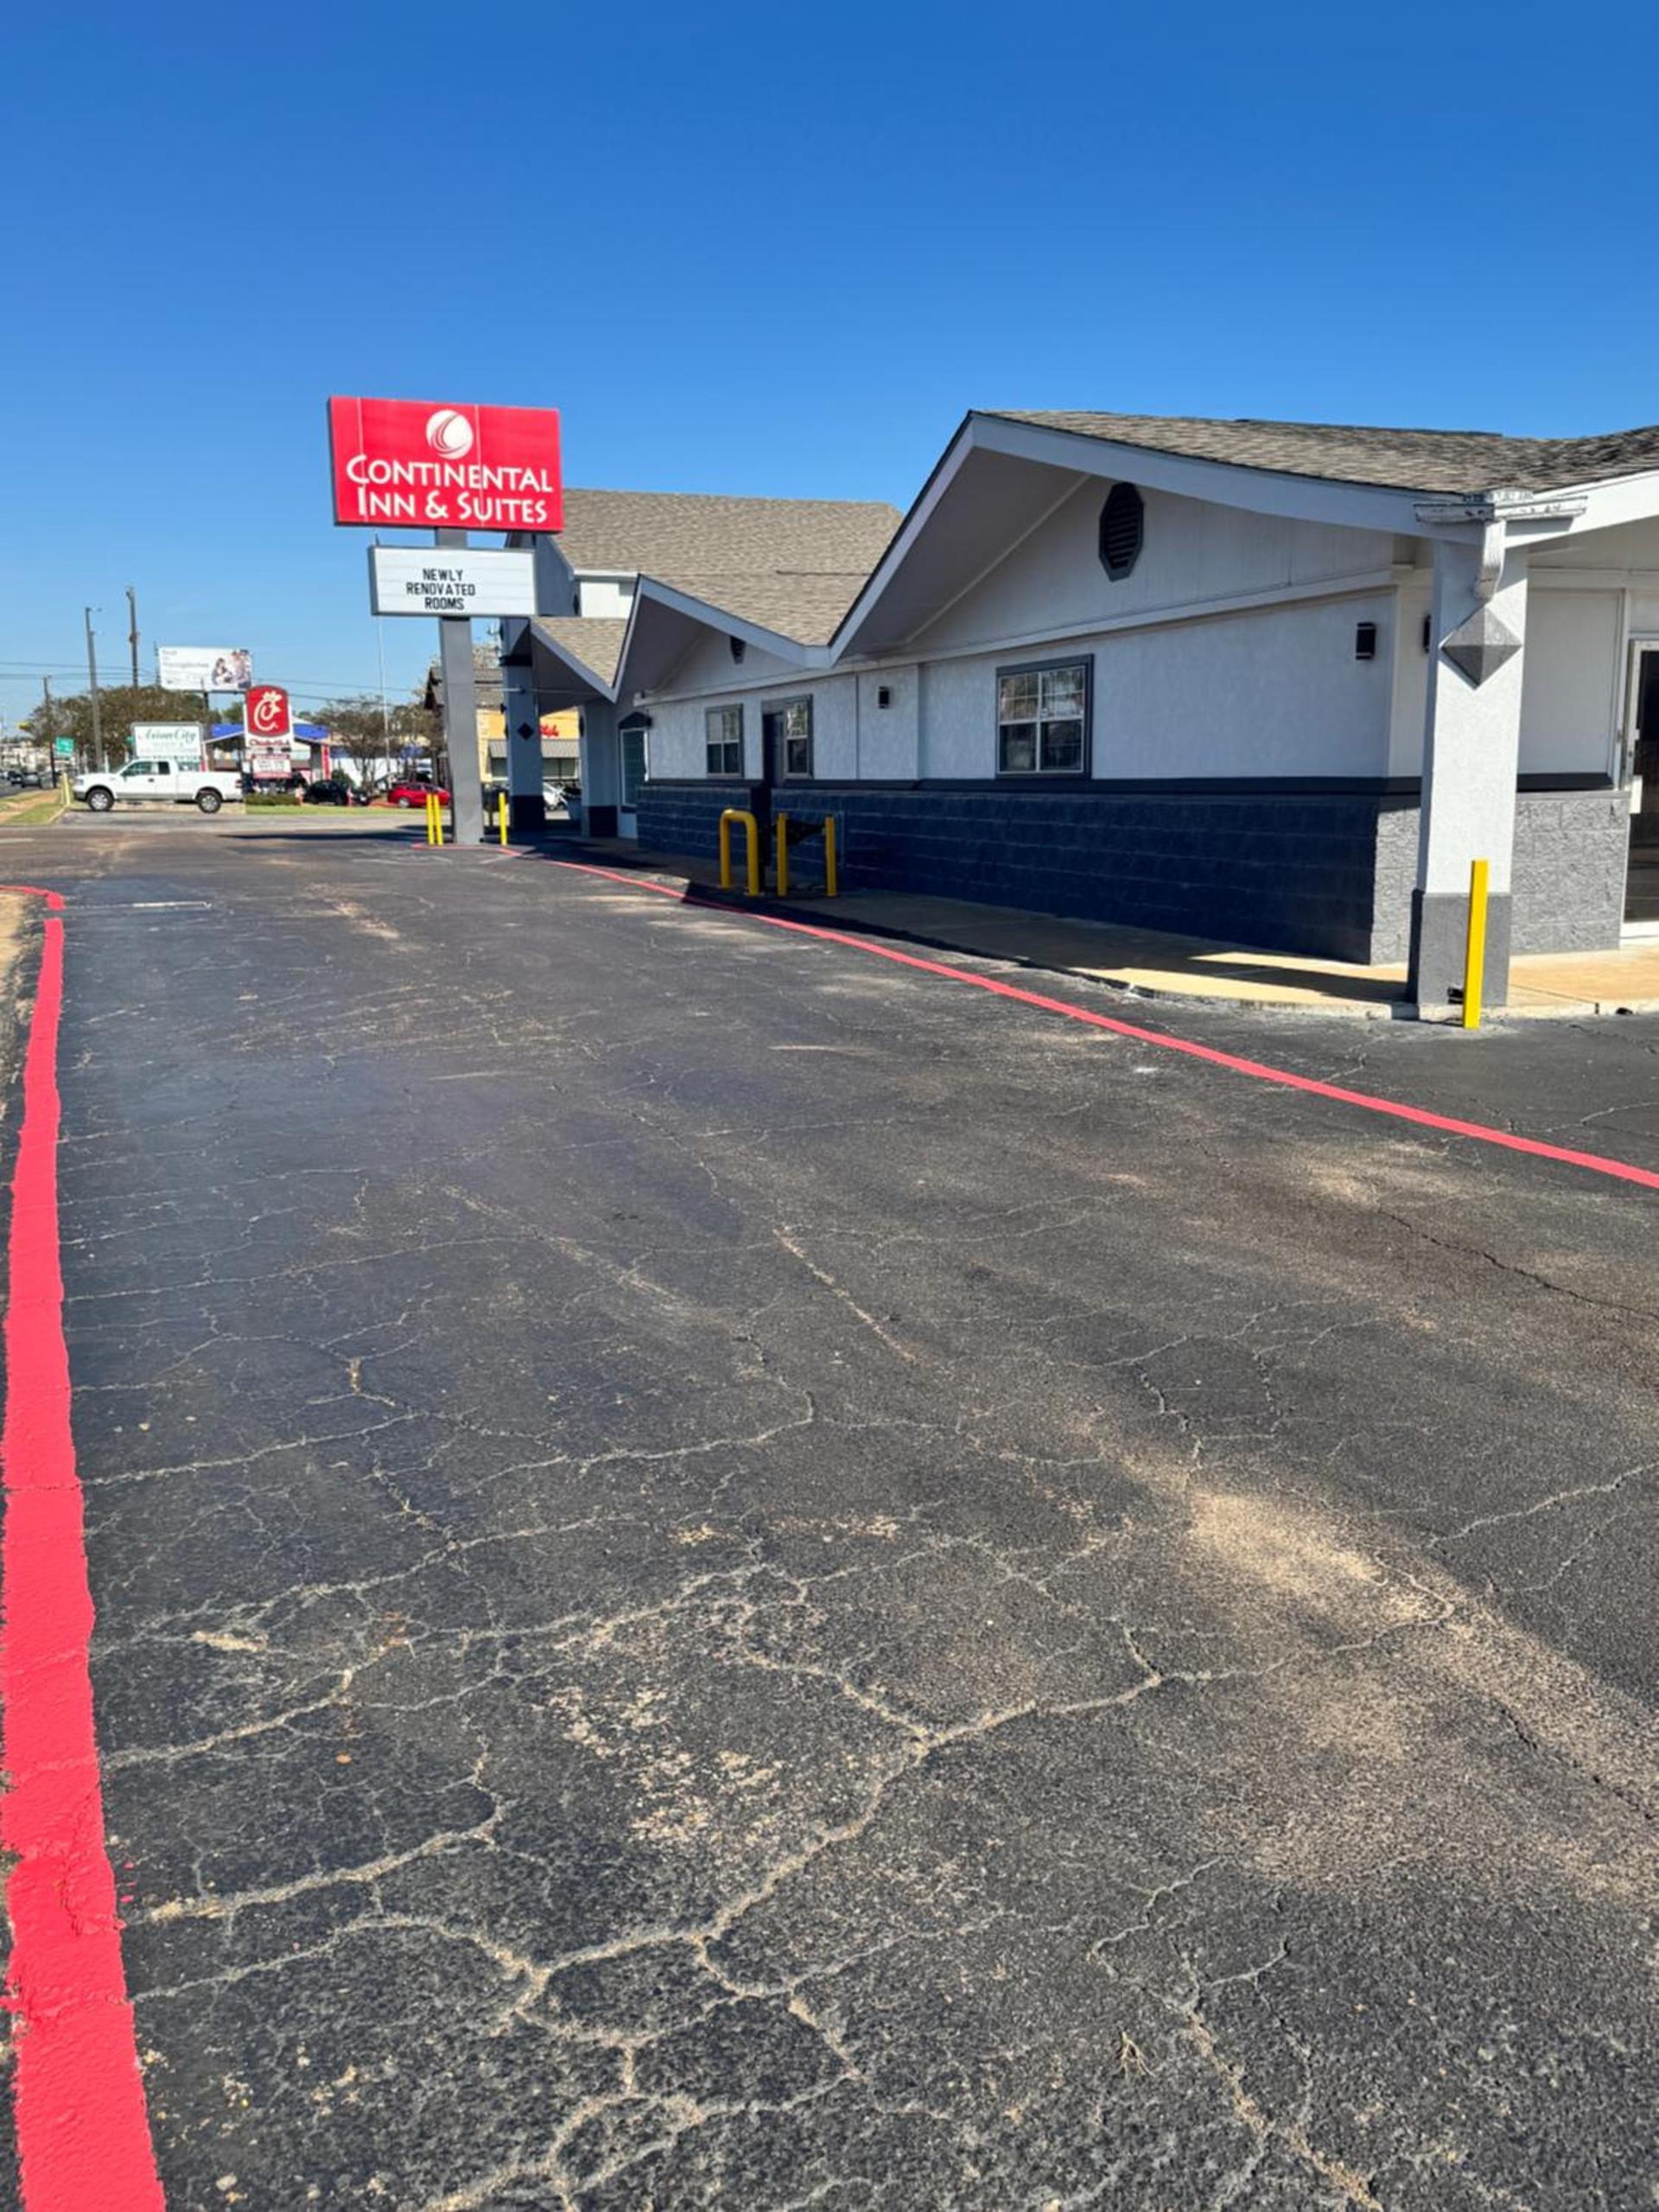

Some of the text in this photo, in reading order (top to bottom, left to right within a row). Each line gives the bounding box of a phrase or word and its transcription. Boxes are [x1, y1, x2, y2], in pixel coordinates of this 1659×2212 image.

[346, 454, 553, 493] CONTINENTAL
[357, 486, 548, 524] INN & SUITES
[422, 568, 464, 582] NEWLY
[406, 582, 476, 596] RENOVATED
[424, 596, 465, 610] ROOMS
